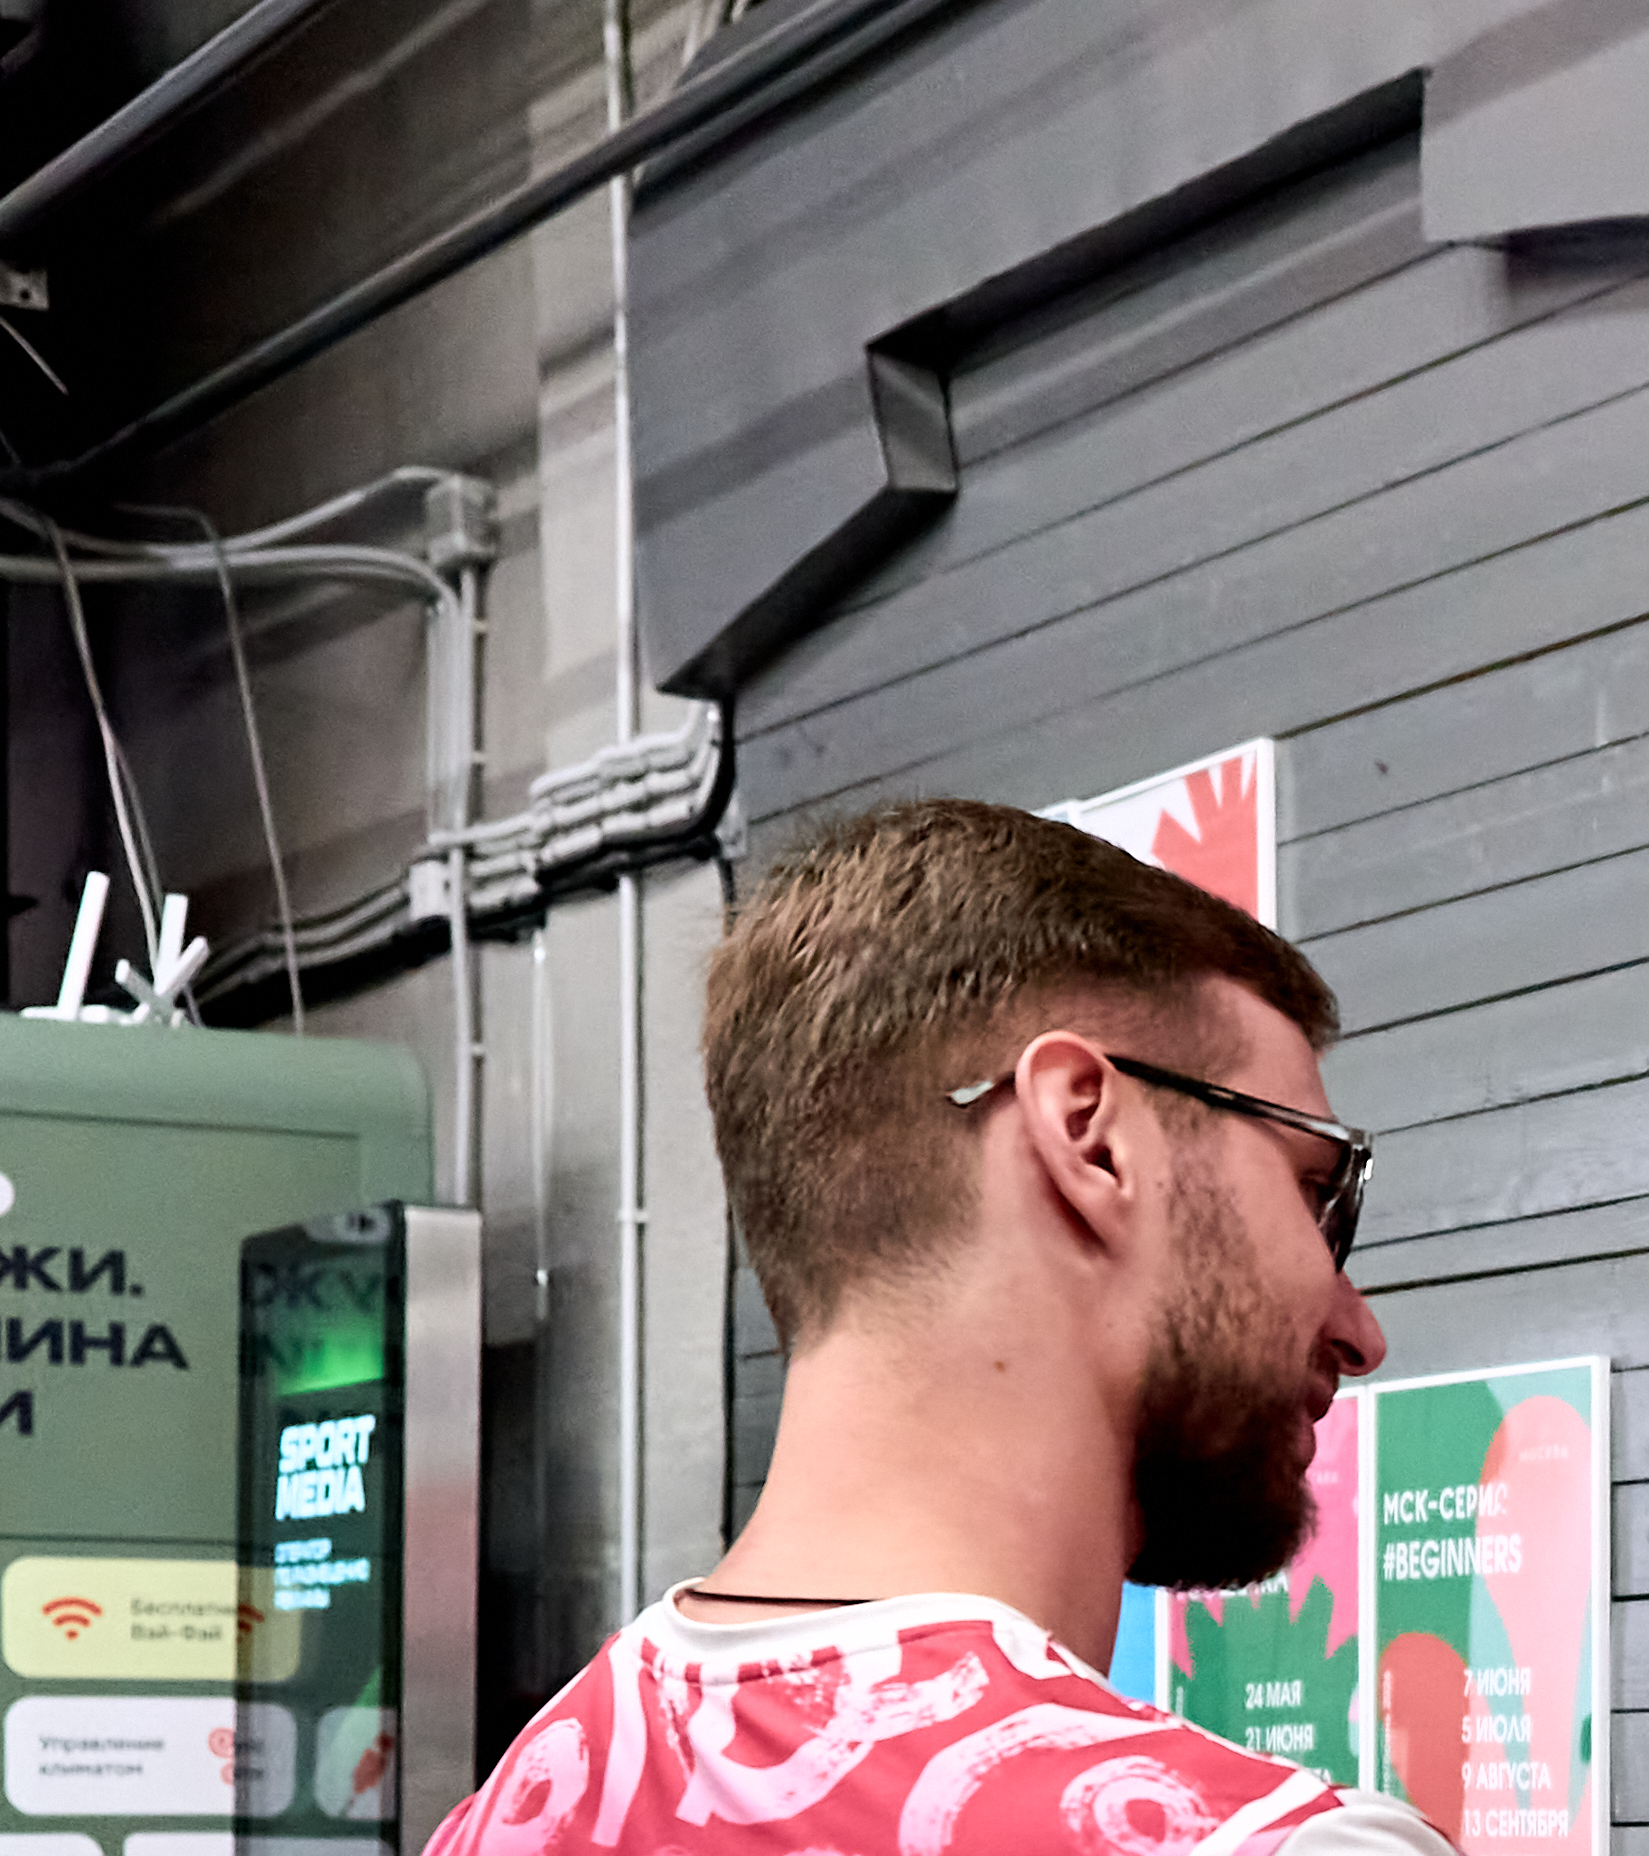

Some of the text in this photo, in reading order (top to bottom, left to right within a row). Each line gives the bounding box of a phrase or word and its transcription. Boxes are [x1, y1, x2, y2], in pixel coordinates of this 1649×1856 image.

[0, 1317, 190, 1371] ИНА
[279, 1415, 376, 1473] SPORT
[275, 1465, 366, 1521] MEDIA
[1383, 1532, 1523, 1582] #BEGINNERS
[1266, 1680, 1302, 1708] МАЯ
[1477, 1666, 1532, 1697] ИЮНЯ
[1265, 1723, 1315, 1751] ИЮНЯ
[1476, 1714, 1532, 1743] ИЮЛЯ
[1476, 1761, 1551, 1791] АВГУСТА
[1484, 1808, 1569, 1838] СЕНТЯБРЯ
